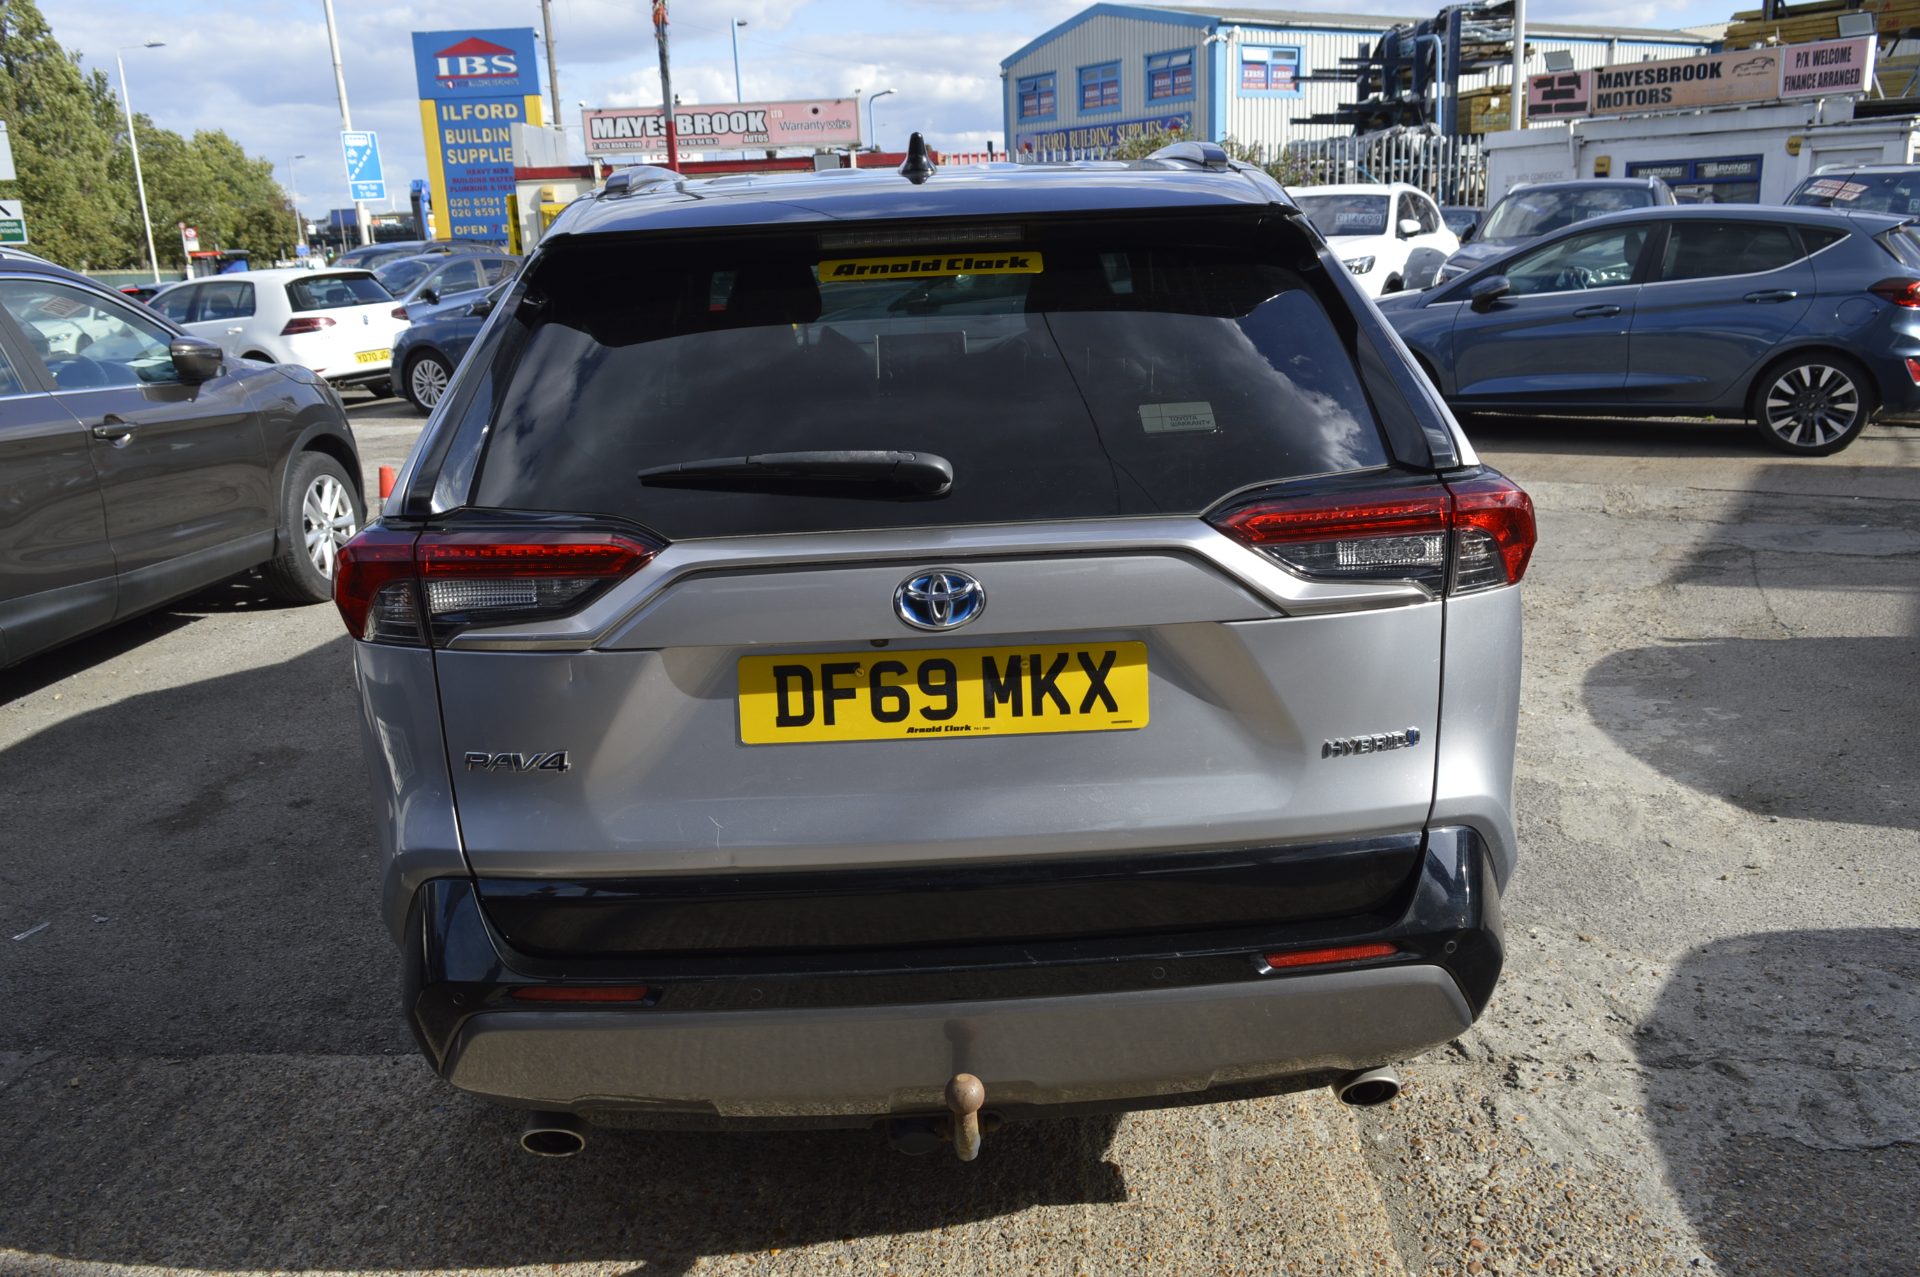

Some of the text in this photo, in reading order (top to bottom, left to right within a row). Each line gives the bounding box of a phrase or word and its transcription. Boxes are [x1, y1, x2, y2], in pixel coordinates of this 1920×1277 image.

[437, 54, 518, 76] IBS
[1795, 46, 1852, 68] P/X WELCOME
[1597, 61, 1722, 89] MAYESBROOK
[1783, 72, 1816, 92] FINANCE
[1817, 68, 1861, 88] ARRANGED
[1597, 87, 1672, 109] MOTORS
[442, 103, 518, 121] ILFORD
[445, 127, 510, 144] BUILDIN
[1069, 126, 1114, 149] BUILDING
[447, 147, 513, 164] SUPPLIE
[649, 153, 691, 161] TESO
[1704, 163, 1751, 173] WARNING!
[450, 198, 470, 207] 020
[451, 208, 471, 217] 020
[454, 225, 487, 235] OPEN
[833, 256, 1030, 276] Arnold Clark
[773, 650, 1119, 728] DF69 MKX
[906, 725, 942, 733] Arnold
[944, 724, 972, 732] Clark
[464, 751, 572, 773] RAV4
